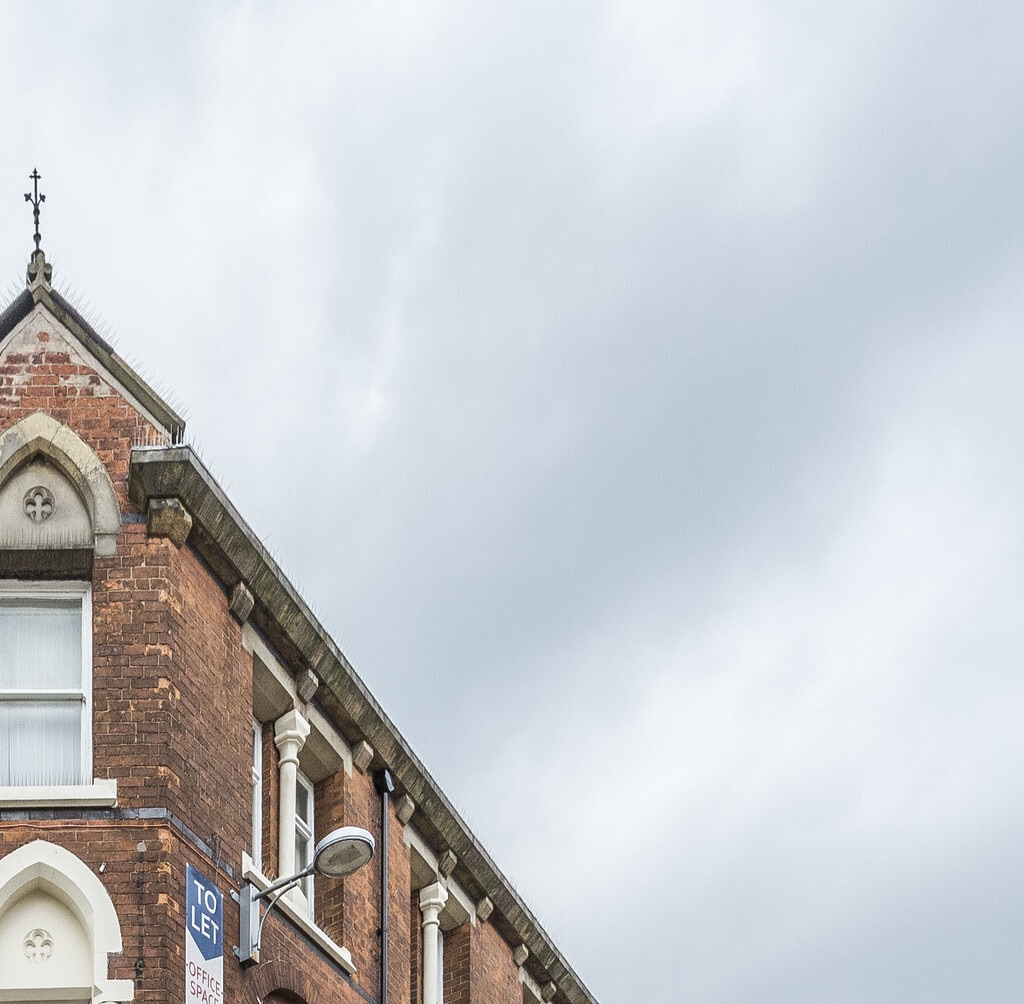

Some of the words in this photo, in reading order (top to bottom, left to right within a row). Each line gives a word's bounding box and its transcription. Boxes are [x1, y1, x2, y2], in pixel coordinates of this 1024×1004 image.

[193, 879, 217, 914] TO
[191, 905, 219, 945] LET
[188, 961, 221, 996] OFFICE
